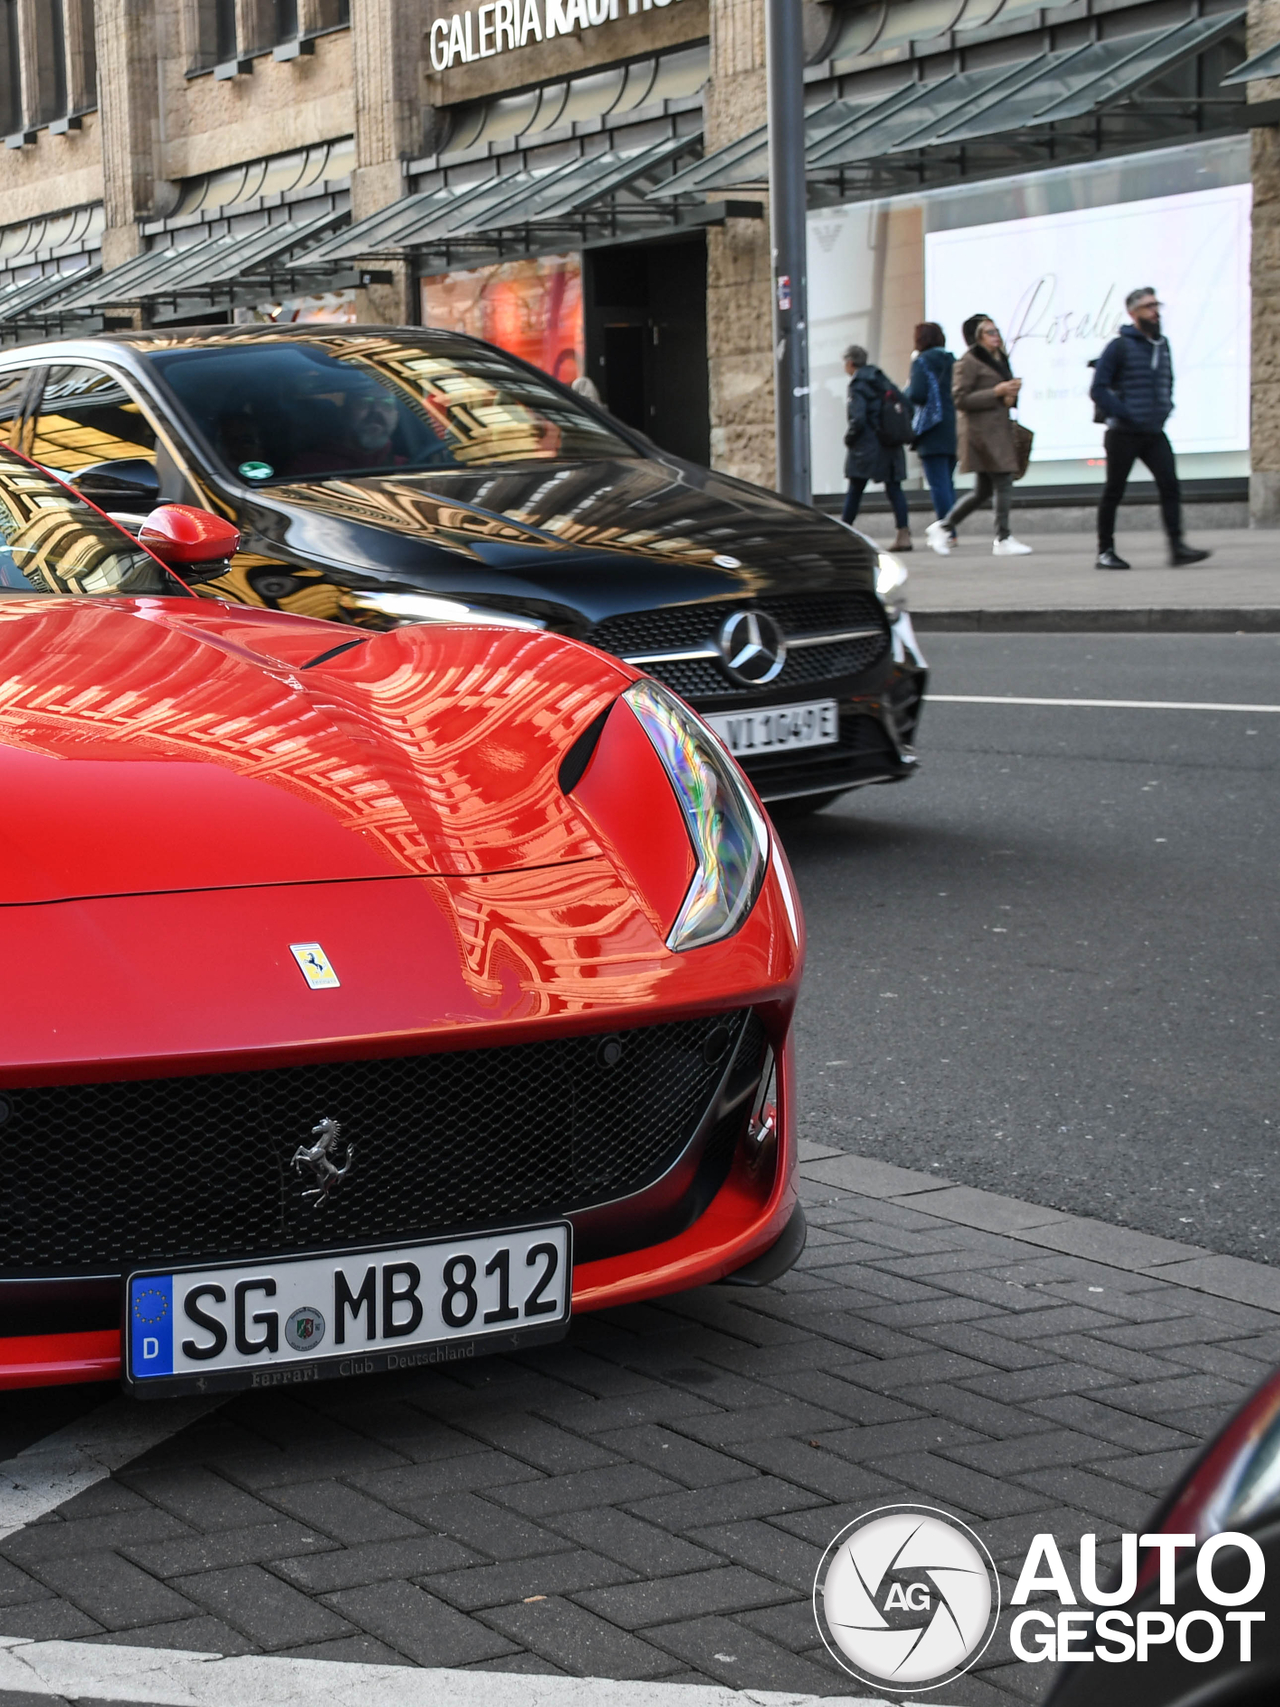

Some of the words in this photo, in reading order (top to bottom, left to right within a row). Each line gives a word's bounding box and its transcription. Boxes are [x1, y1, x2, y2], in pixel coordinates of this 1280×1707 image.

[429, 0, 542, 72] GALERIA
[181, 1276, 280, 1361] SG
[333, 1260, 424, 1345] MB
[440, 1242, 559, 1328] 812
[142, 1336, 160, 1360] D
[250, 1364, 319, 1388] Ferrari
[339, 1359, 375, 1377] Club
[386, 1343, 475, 1371] Deutschland
